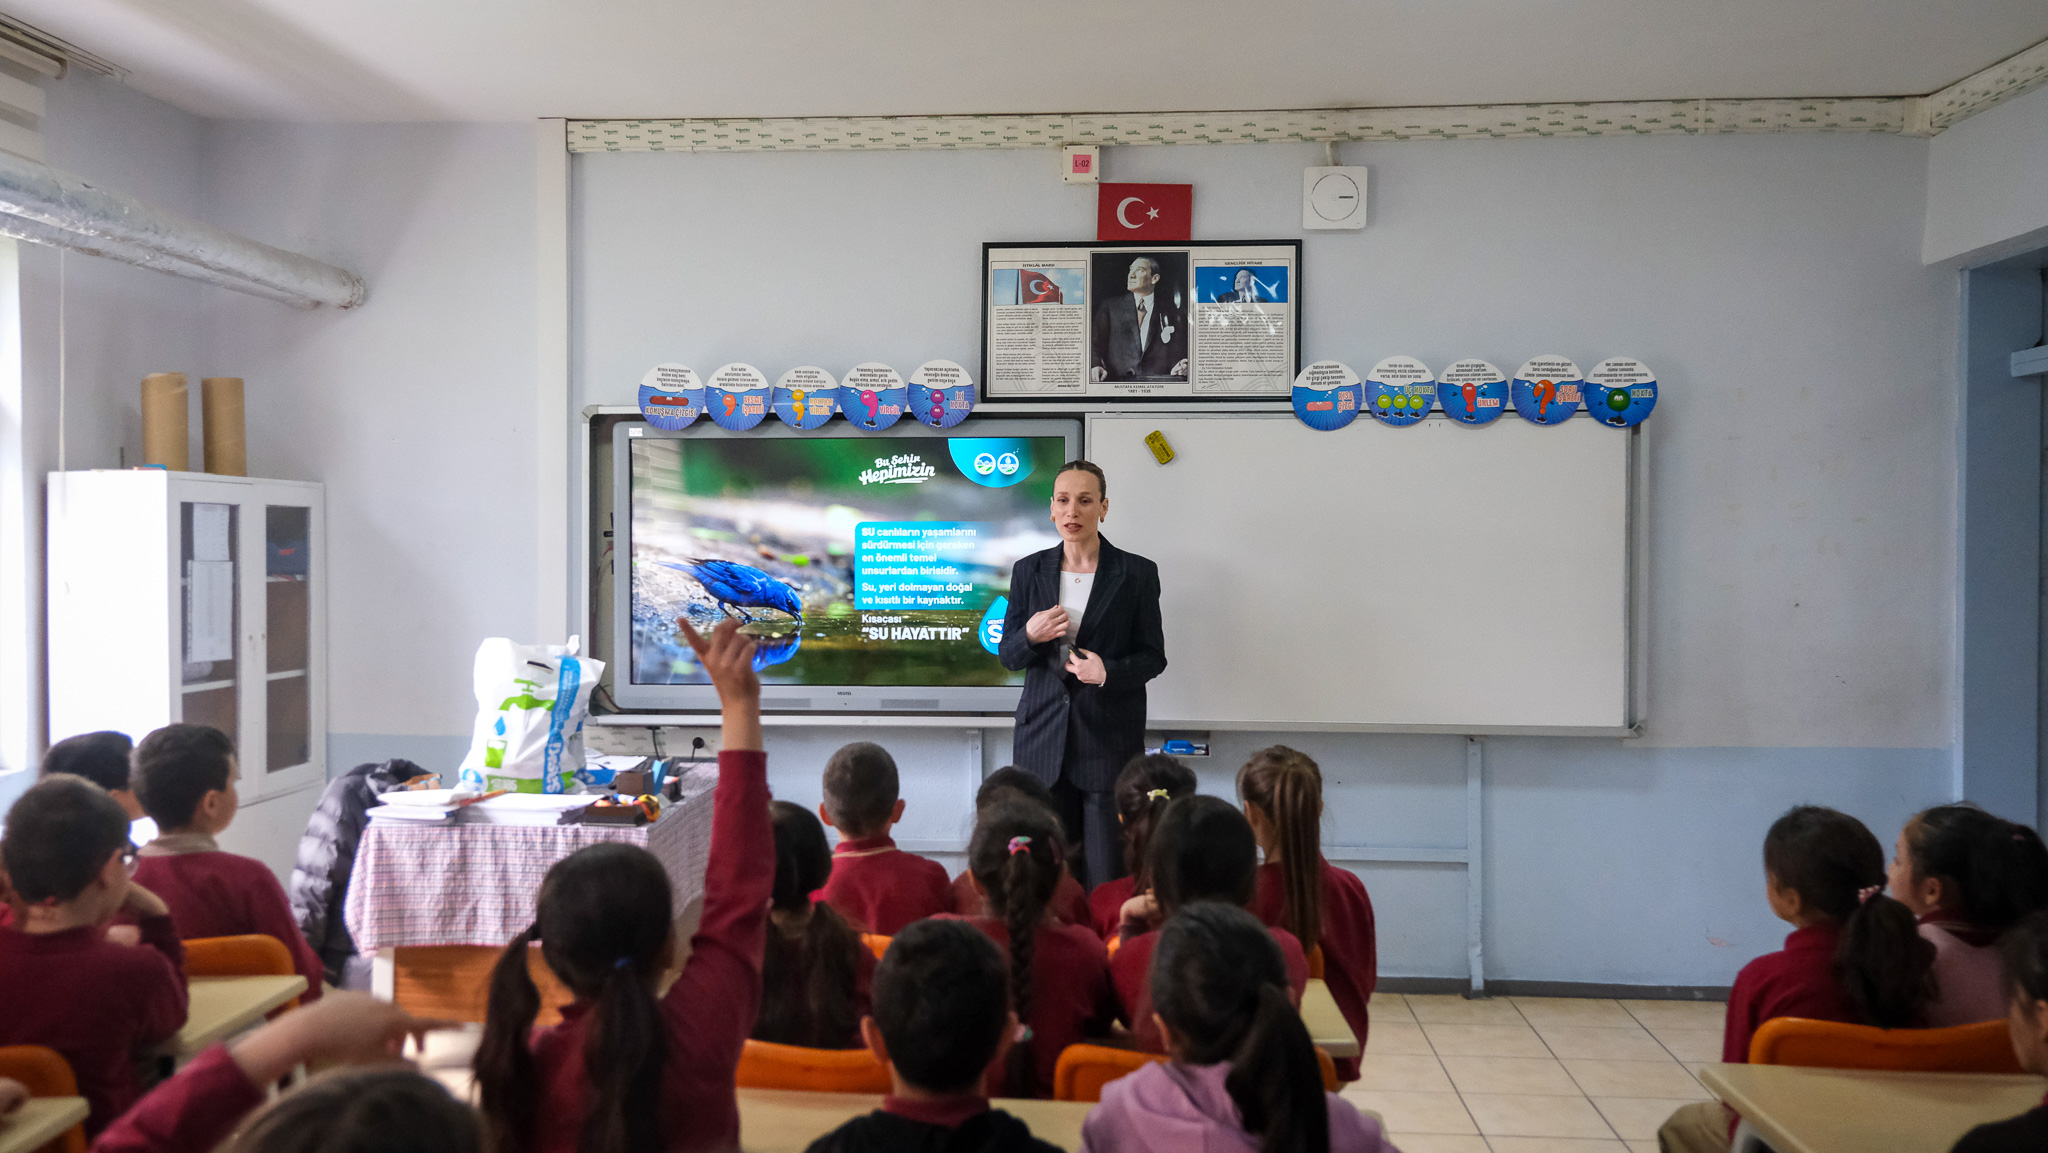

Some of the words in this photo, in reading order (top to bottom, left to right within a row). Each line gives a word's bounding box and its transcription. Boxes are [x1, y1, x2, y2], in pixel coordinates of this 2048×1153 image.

[1413, 386, 1434, 394] NOKTA
[1559, 385, 1578, 394] SORU
[1631, 389, 1653, 398] NOKTA
[743, 395, 763, 404] KESME
[1477, 397, 1500, 407] ÜNLEM
[1556, 392, 1581, 405] İŞARETİ
[879, 404, 900, 415] VİRGÜL
[950, 400, 969, 409] NOKTA
[645, 407, 674, 418] KONUŞMA
[675, 408, 696, 419] ÇİZGİSİ
[874, 457, 890, 468] Bu
[891, 454, 920, 466] Şehir
[858, 464, 935, 485] Hepimizin
[862, 528, 875, 536] SU
[877, 528, 920, 536] canlıların
[922, 528, 976, 538] yaşamlarını
[862, 540, 916, 549] sürdürmesi
[917, 540, 935, 551] için
[936, 540, 975, 551] gereken
[875, 553, 907, 562] önemli
[909, 553, 937, 562] temel
[862, 566, 918, 575] unsurlardan
[920, 566, 959, 575] birisidir.
[862, 583, 877, 593] Su,
[879, 583, 897, 593] yeri
[899, 583, 944, 593] dolmayan
[946, 583, 972, 594] doğal
[875, 596, 900, 604] kısıtlı
[902, 596, 915, 604] bir
[917, 596, 964, 606] kaynaktır.
[862, 614, 901, 624] Kısacası
